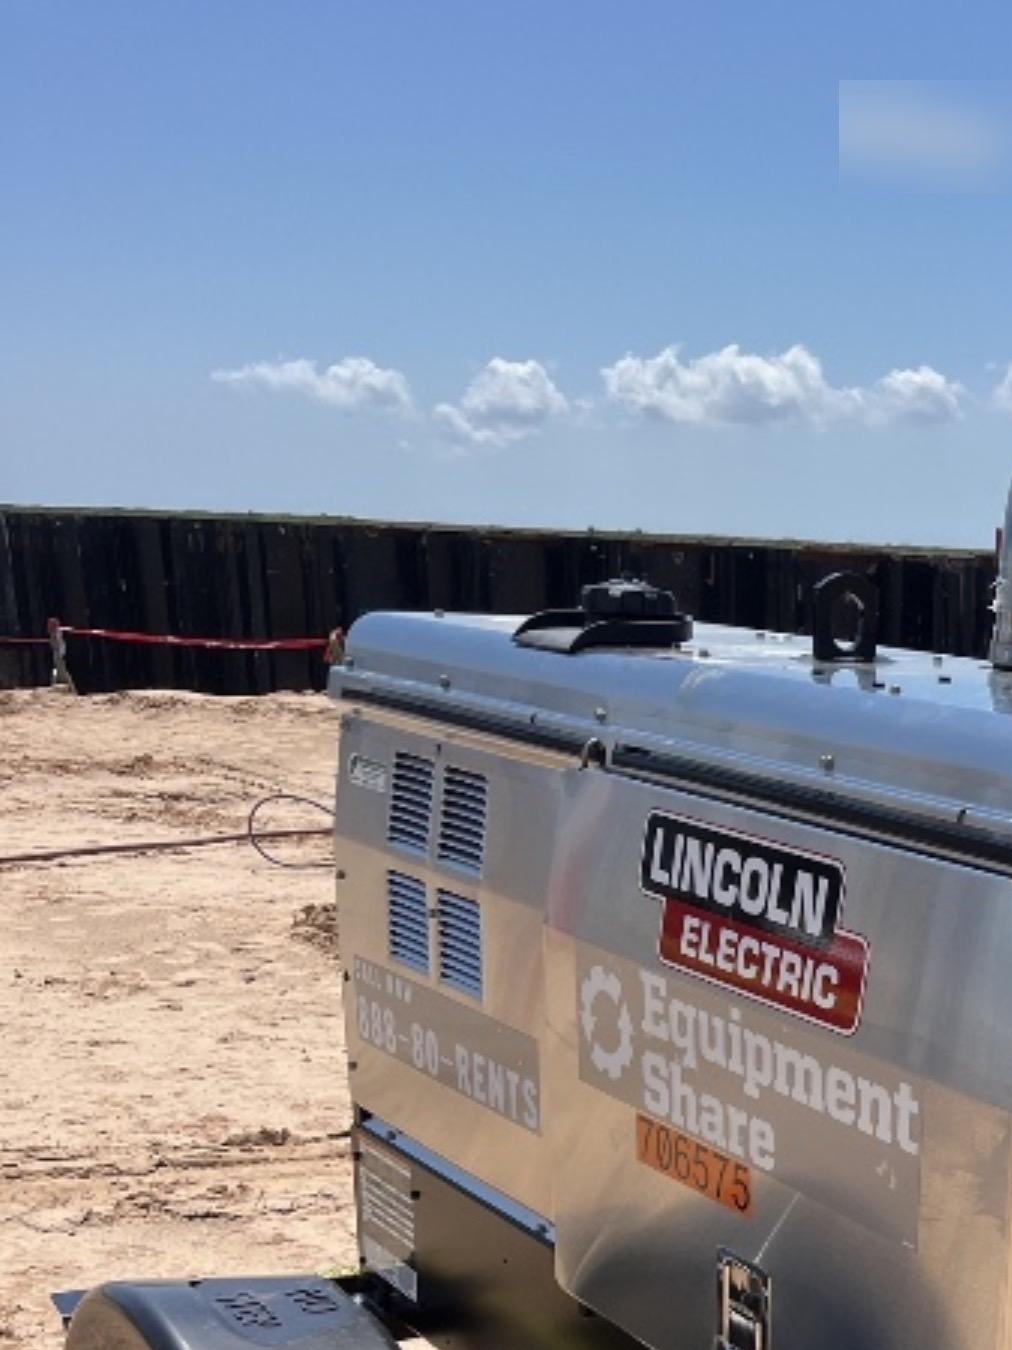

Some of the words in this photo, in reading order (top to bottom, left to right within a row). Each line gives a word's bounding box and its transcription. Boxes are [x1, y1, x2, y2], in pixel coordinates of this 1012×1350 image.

[651, 827, 829, 937] LINCOLN
[680, 914, 839, 1009] ELECTRIC
[359, 995, 539, 1129] 888-80-RENTS
[640, 967, 919, 1155] Equipment
[641, 1051, 775, 1171] Share
[639, 1117, 751, 1213] 706575
